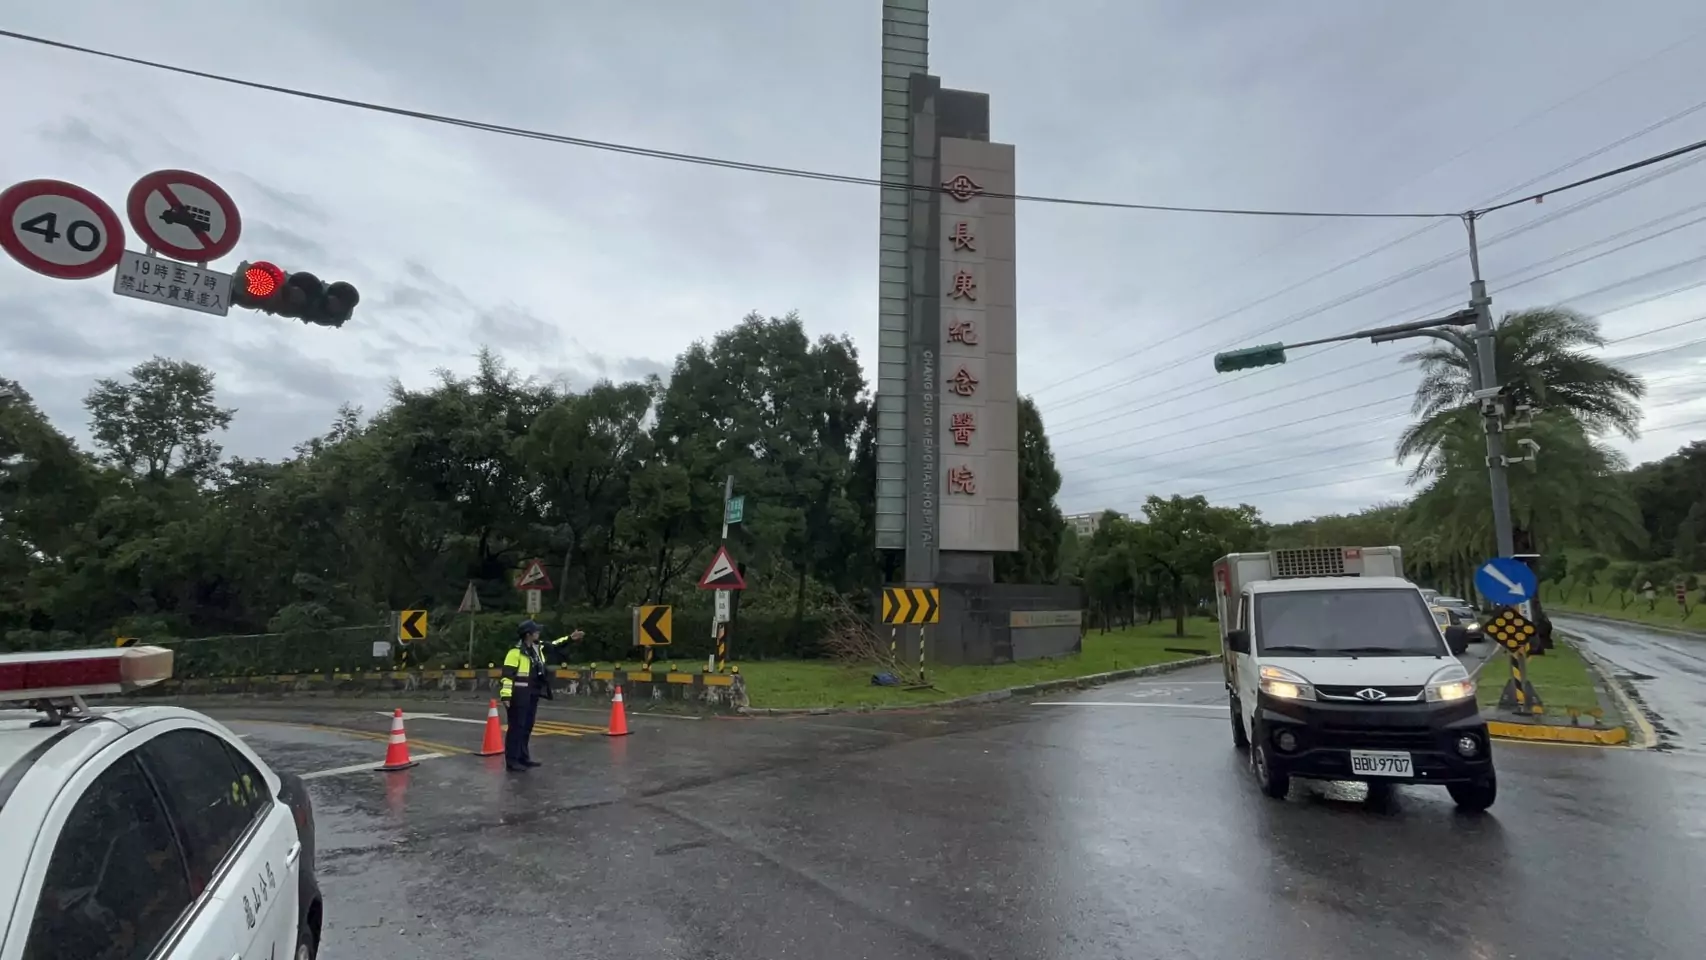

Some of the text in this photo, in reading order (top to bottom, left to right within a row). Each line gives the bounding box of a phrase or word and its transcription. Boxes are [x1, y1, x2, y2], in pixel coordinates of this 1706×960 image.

[21, 212, 101, 252] 40
[120, 275, 223, 310] 禁止大貨車進入
[946, 221, 979, 496] 長庚紀念醫院
[921, 350, 934, 549] CHANG GUNG MEMORIAL HOSPITAL
[1352, 756, 1410, 773] BBU-9707
